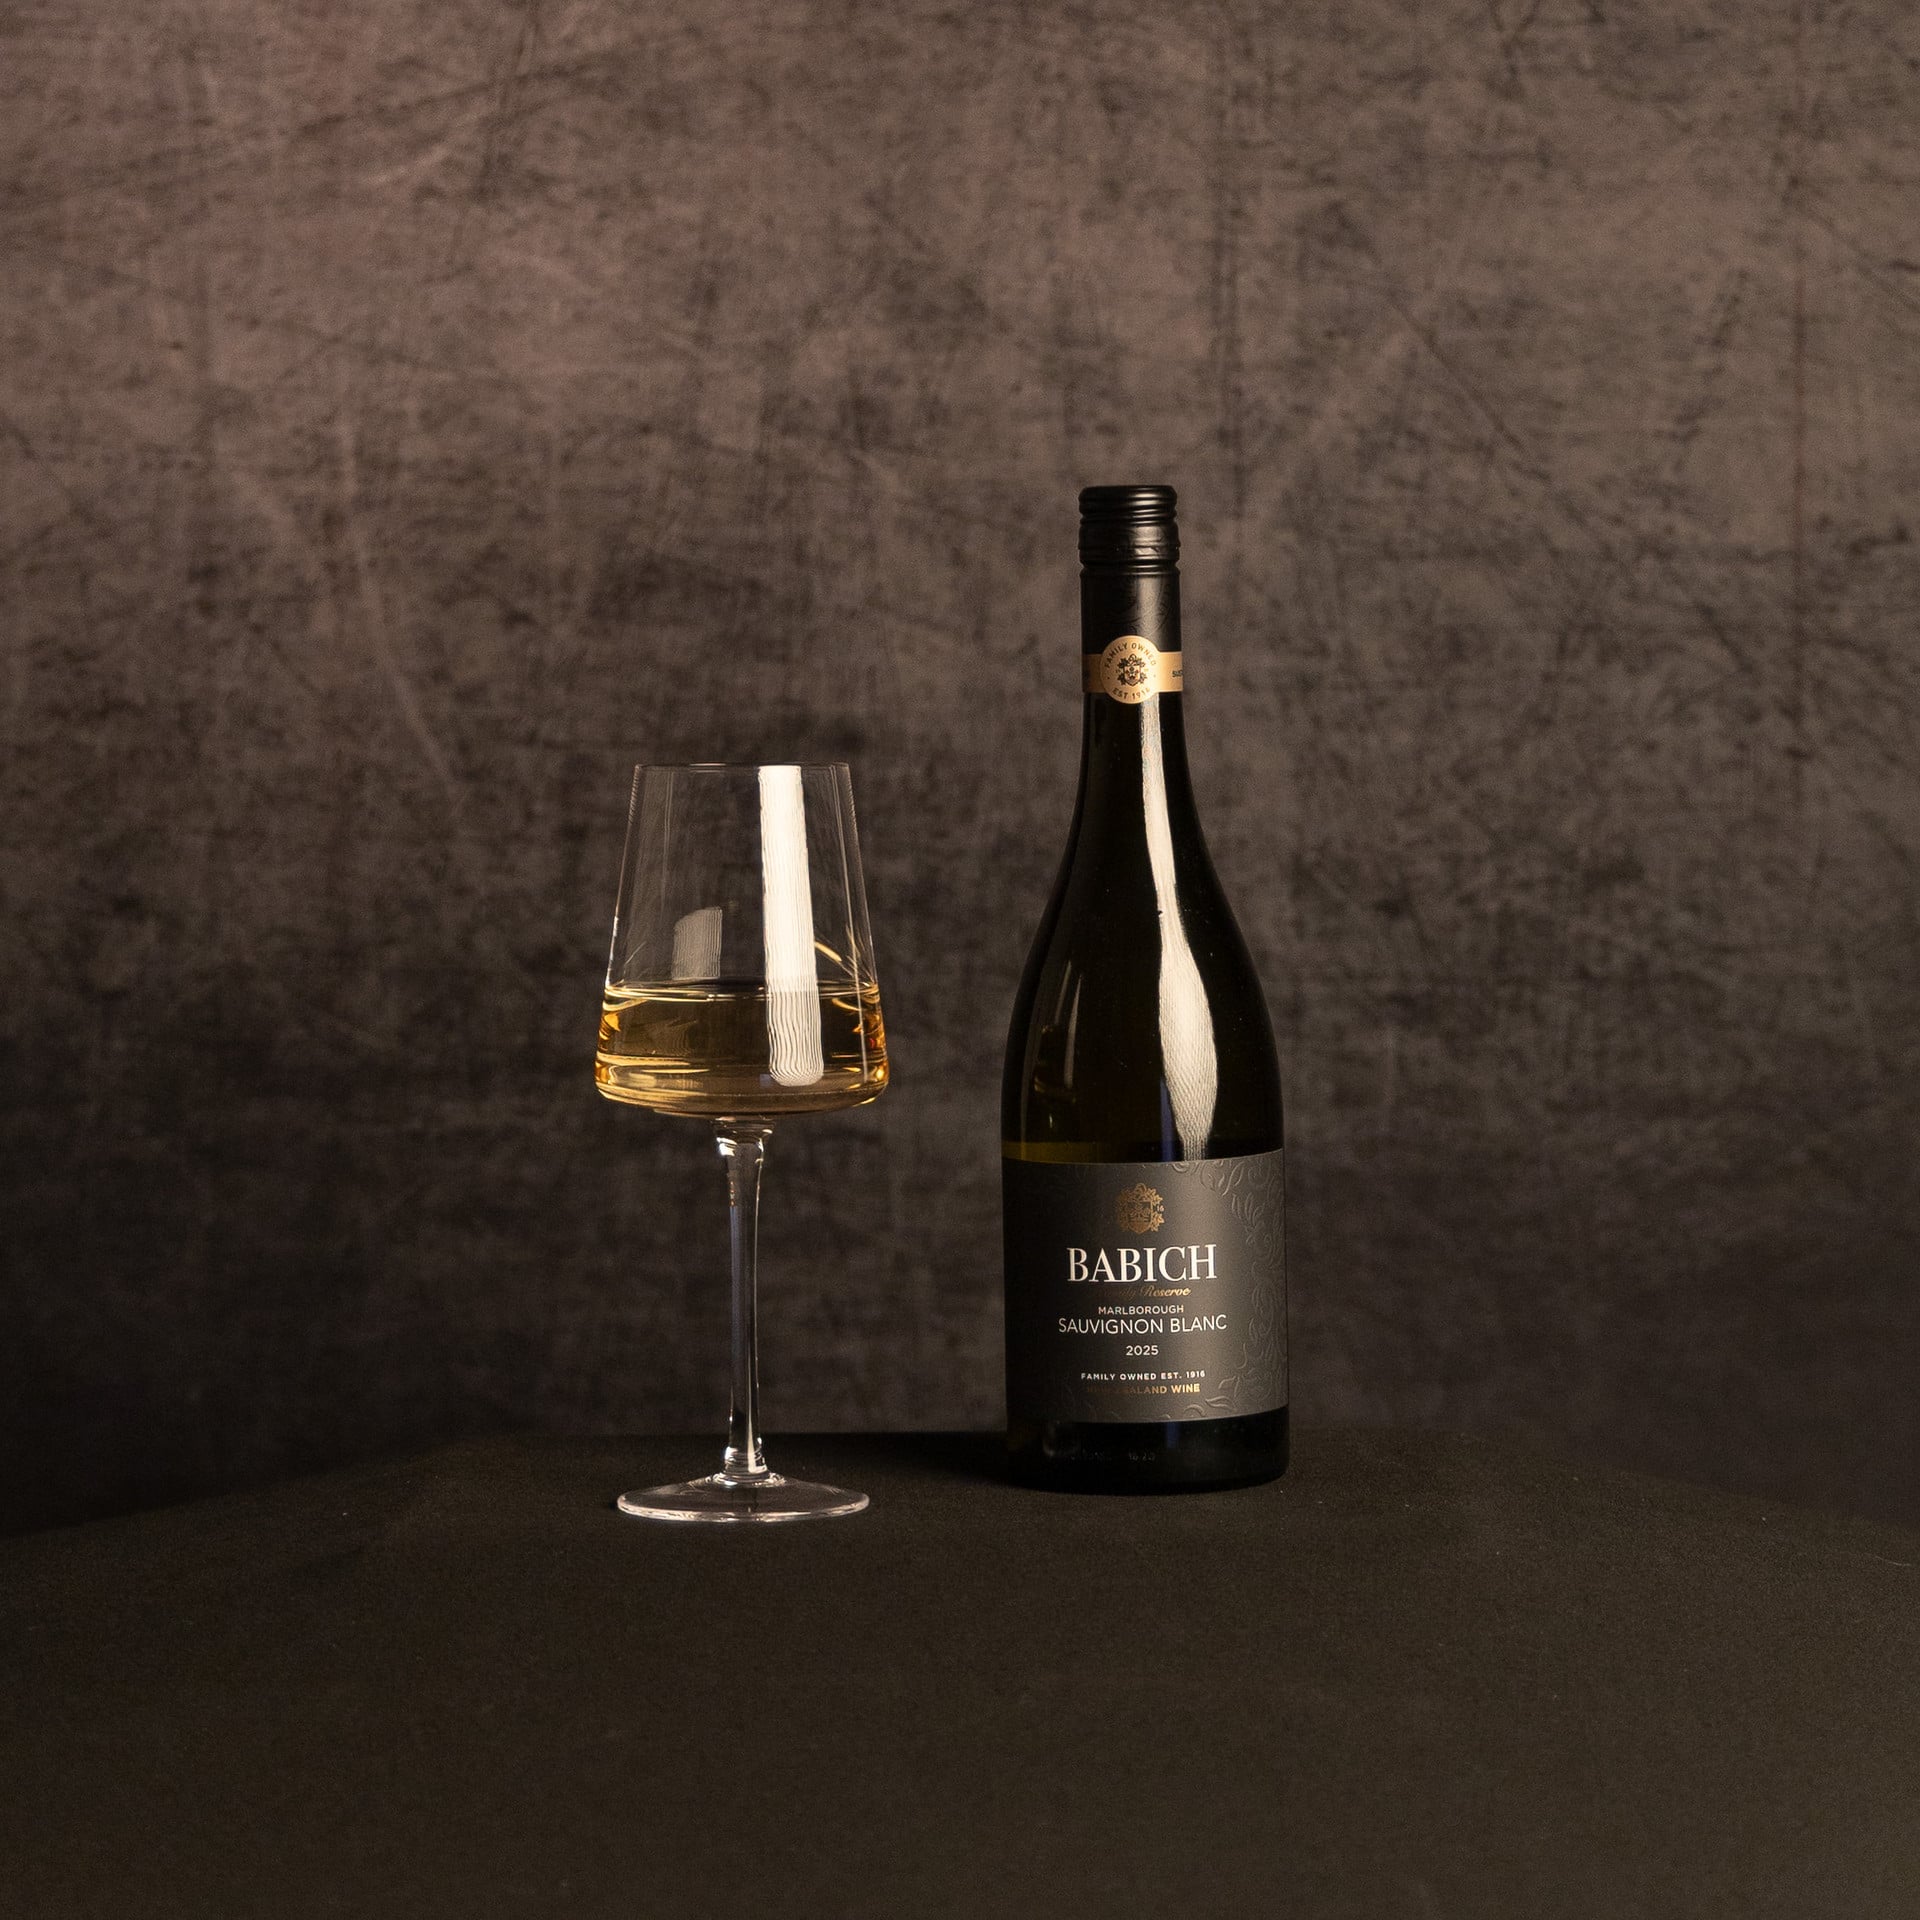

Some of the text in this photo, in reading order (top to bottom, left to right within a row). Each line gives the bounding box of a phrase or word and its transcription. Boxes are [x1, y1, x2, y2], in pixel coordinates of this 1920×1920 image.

[1104, 643, 1157, 669] FAMILY OWNED
[1112, 687, 1129, 700] EST
[1066, 1243, 1218, 1283] BABICH
[1098, 1304, 1185, 1316] MARLBOROUGH
[1058, 1314, 1228, 1335] SAUVIGNON BLANC
[1125, 1345, 1160, 1356] 2025
[1080, 1370, 1206, 1381] FAMILY OWNED EST. 1916
[1170, 1383, 1201, 1394] WINE
